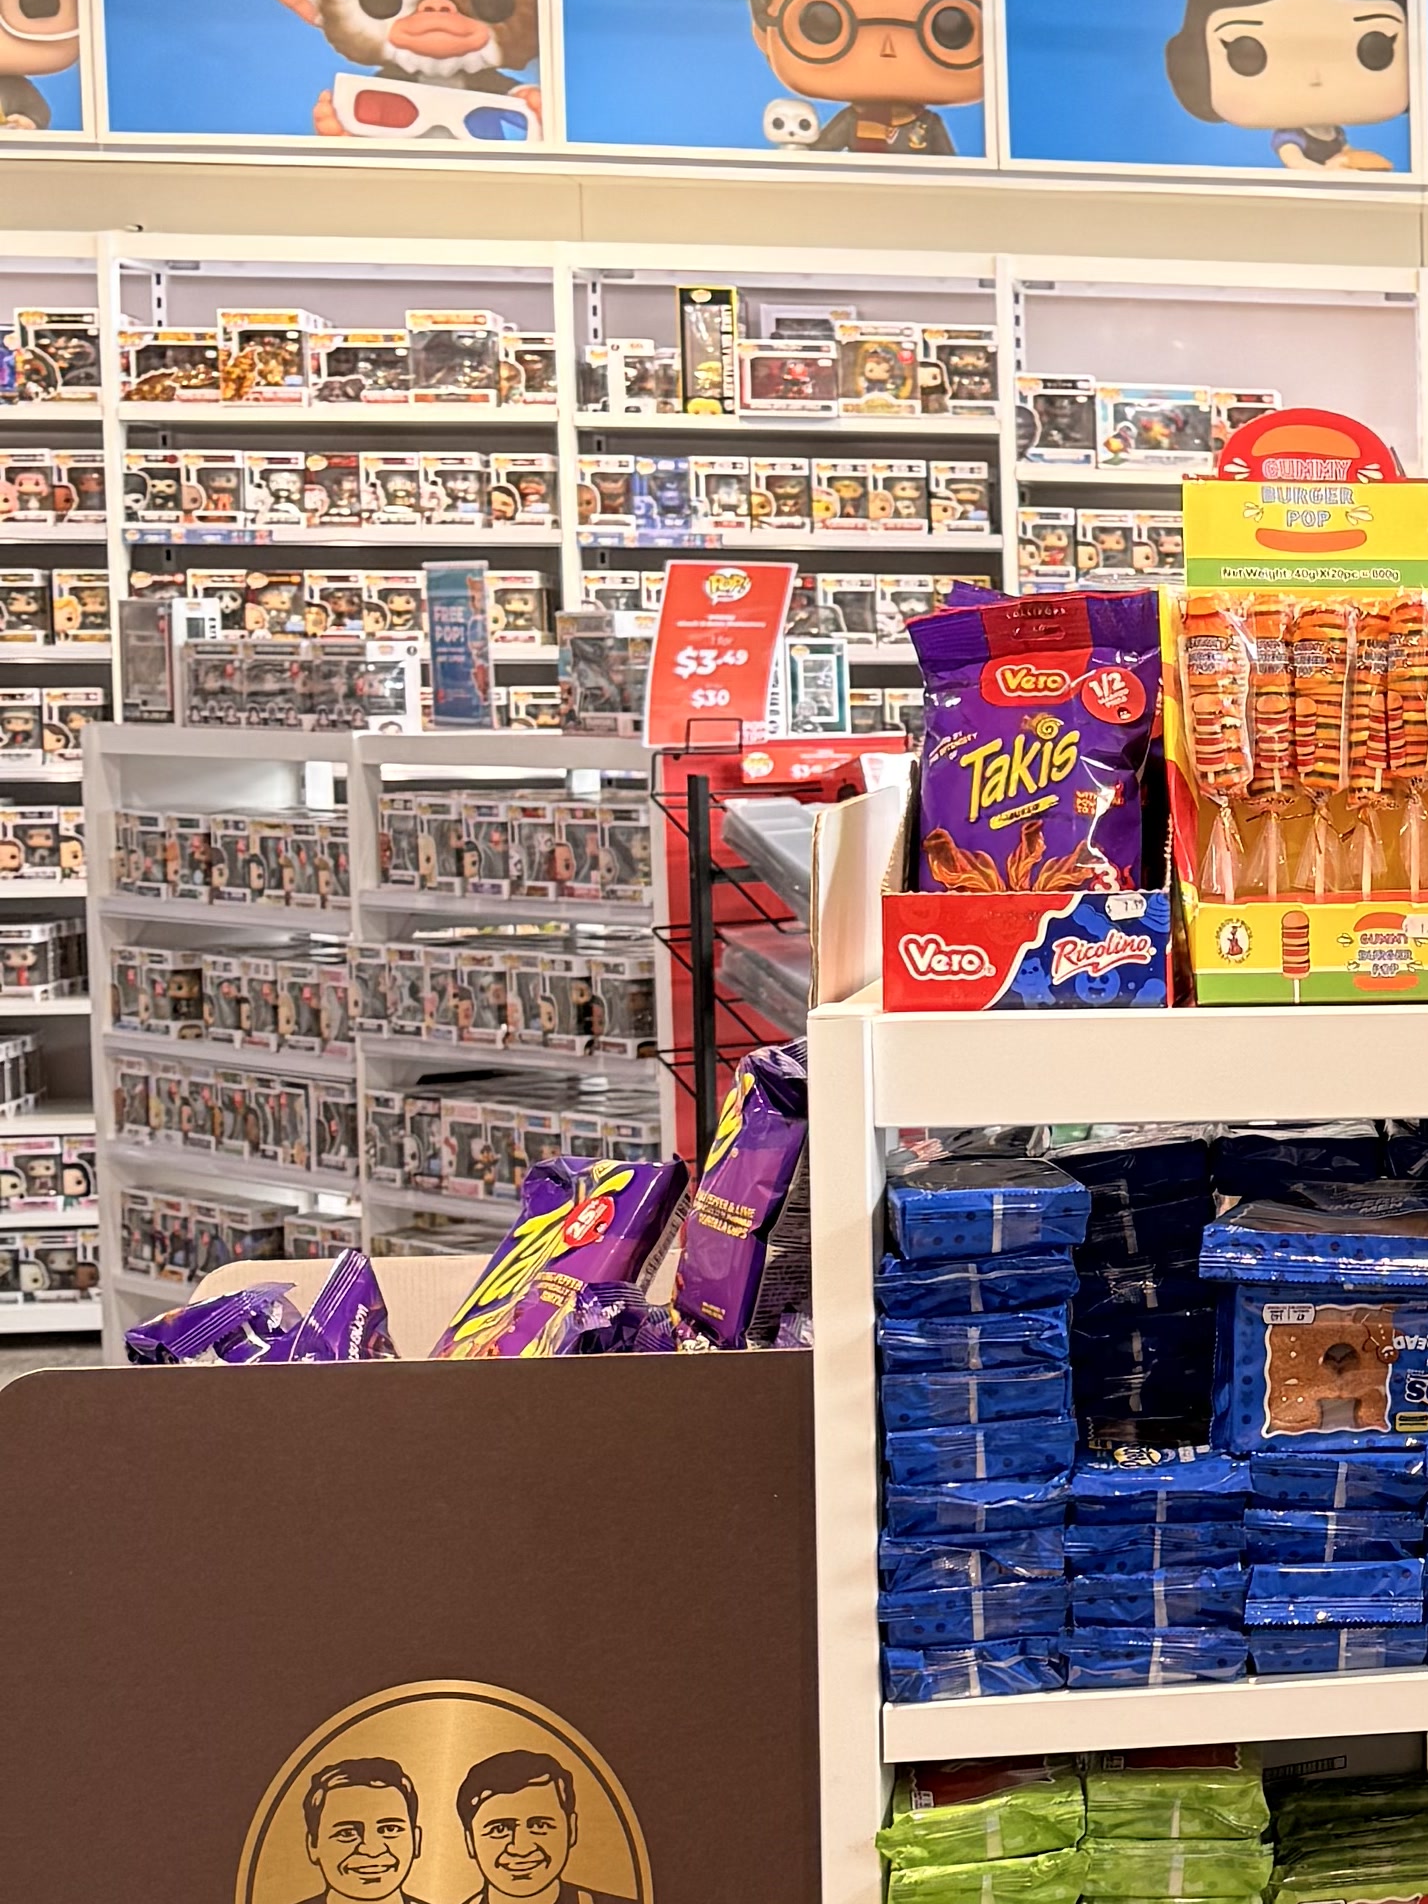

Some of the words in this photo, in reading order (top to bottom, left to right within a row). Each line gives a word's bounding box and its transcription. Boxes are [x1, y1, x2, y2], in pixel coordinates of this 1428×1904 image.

[1262, 458, 1353, 481] GUMMY
[1261, 485, 1355, 505] BURGER
[1286, 510, 1331, 527] POP
[673, 646, 749, 680] $3.49
[1000, 667, 1064, 691] Vero
[690, 688, 731, 709] $30
[960, 729, 1081, 823] Takis
[906, 940, 986, 974] Vero
[1053, 933, 1152, 971] Ricolino
